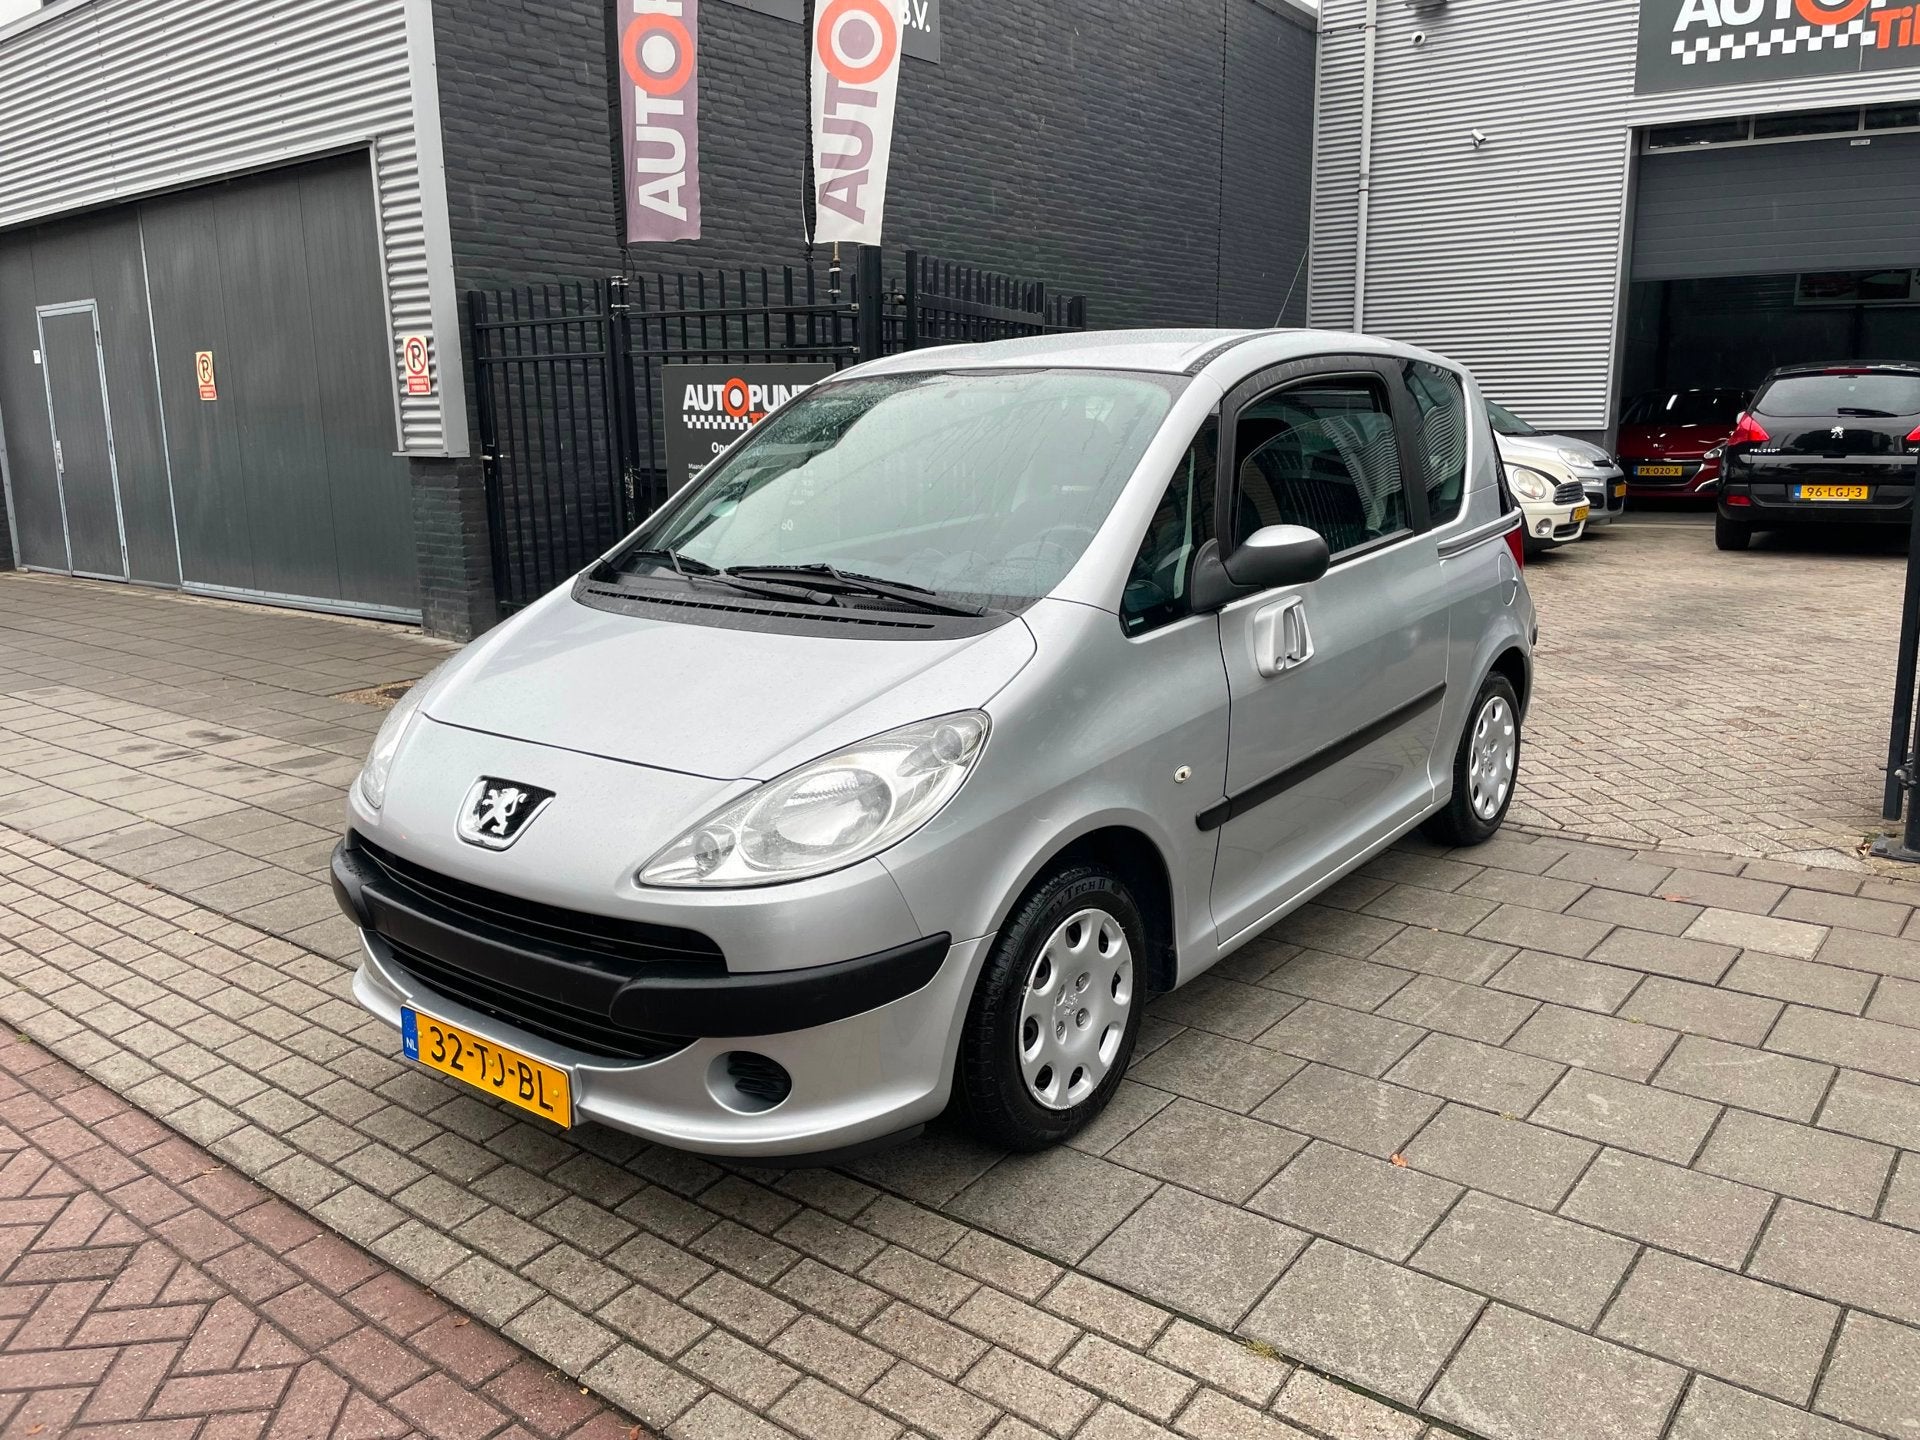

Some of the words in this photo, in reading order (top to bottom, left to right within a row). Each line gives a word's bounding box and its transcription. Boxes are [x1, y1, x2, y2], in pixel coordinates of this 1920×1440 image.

[1640, 467, 1679, 475] PX-020-X
[1807, 487, 1862, 497] 96-LGJ-3
[406, 1037, 417, 1051] NL
[429, 1025, 554, 1112] 32-TJ-BL
